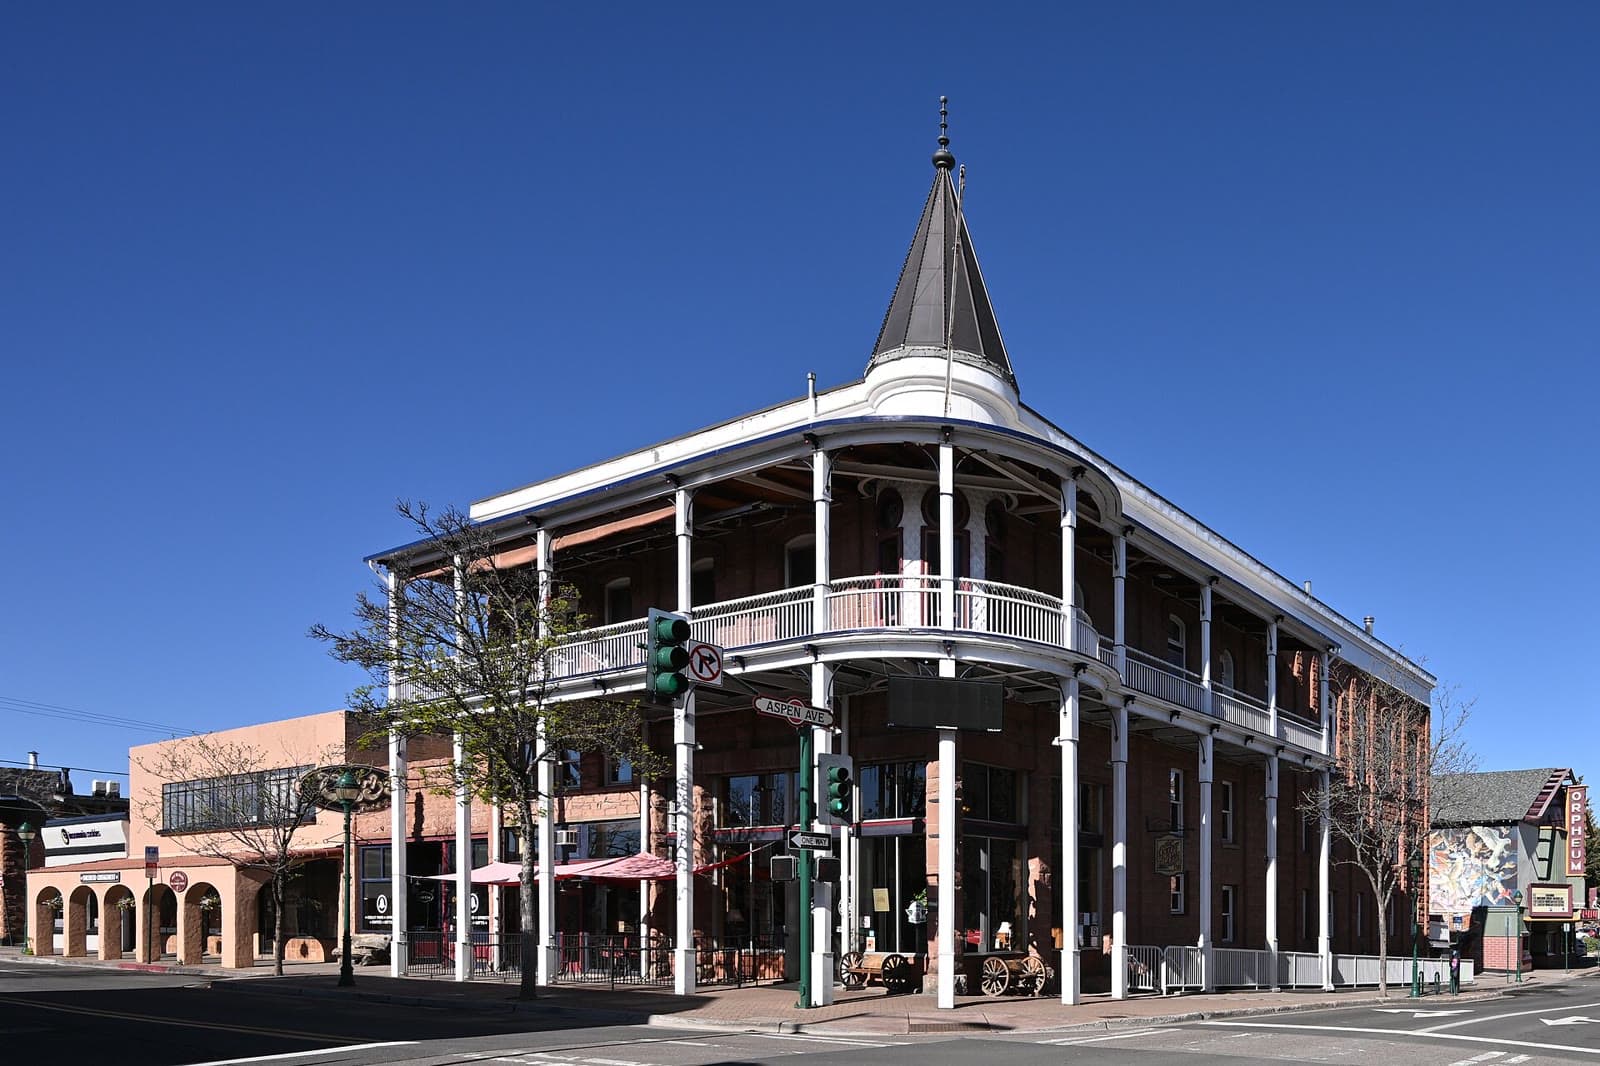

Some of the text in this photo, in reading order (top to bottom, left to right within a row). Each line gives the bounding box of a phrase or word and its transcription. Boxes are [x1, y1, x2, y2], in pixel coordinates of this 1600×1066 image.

[766, 701, 825, 723] ASPEN AVE
[802, 836, 827, 845] ONE WAY
[1571, 791, 1582, 871] ORPHEUM
